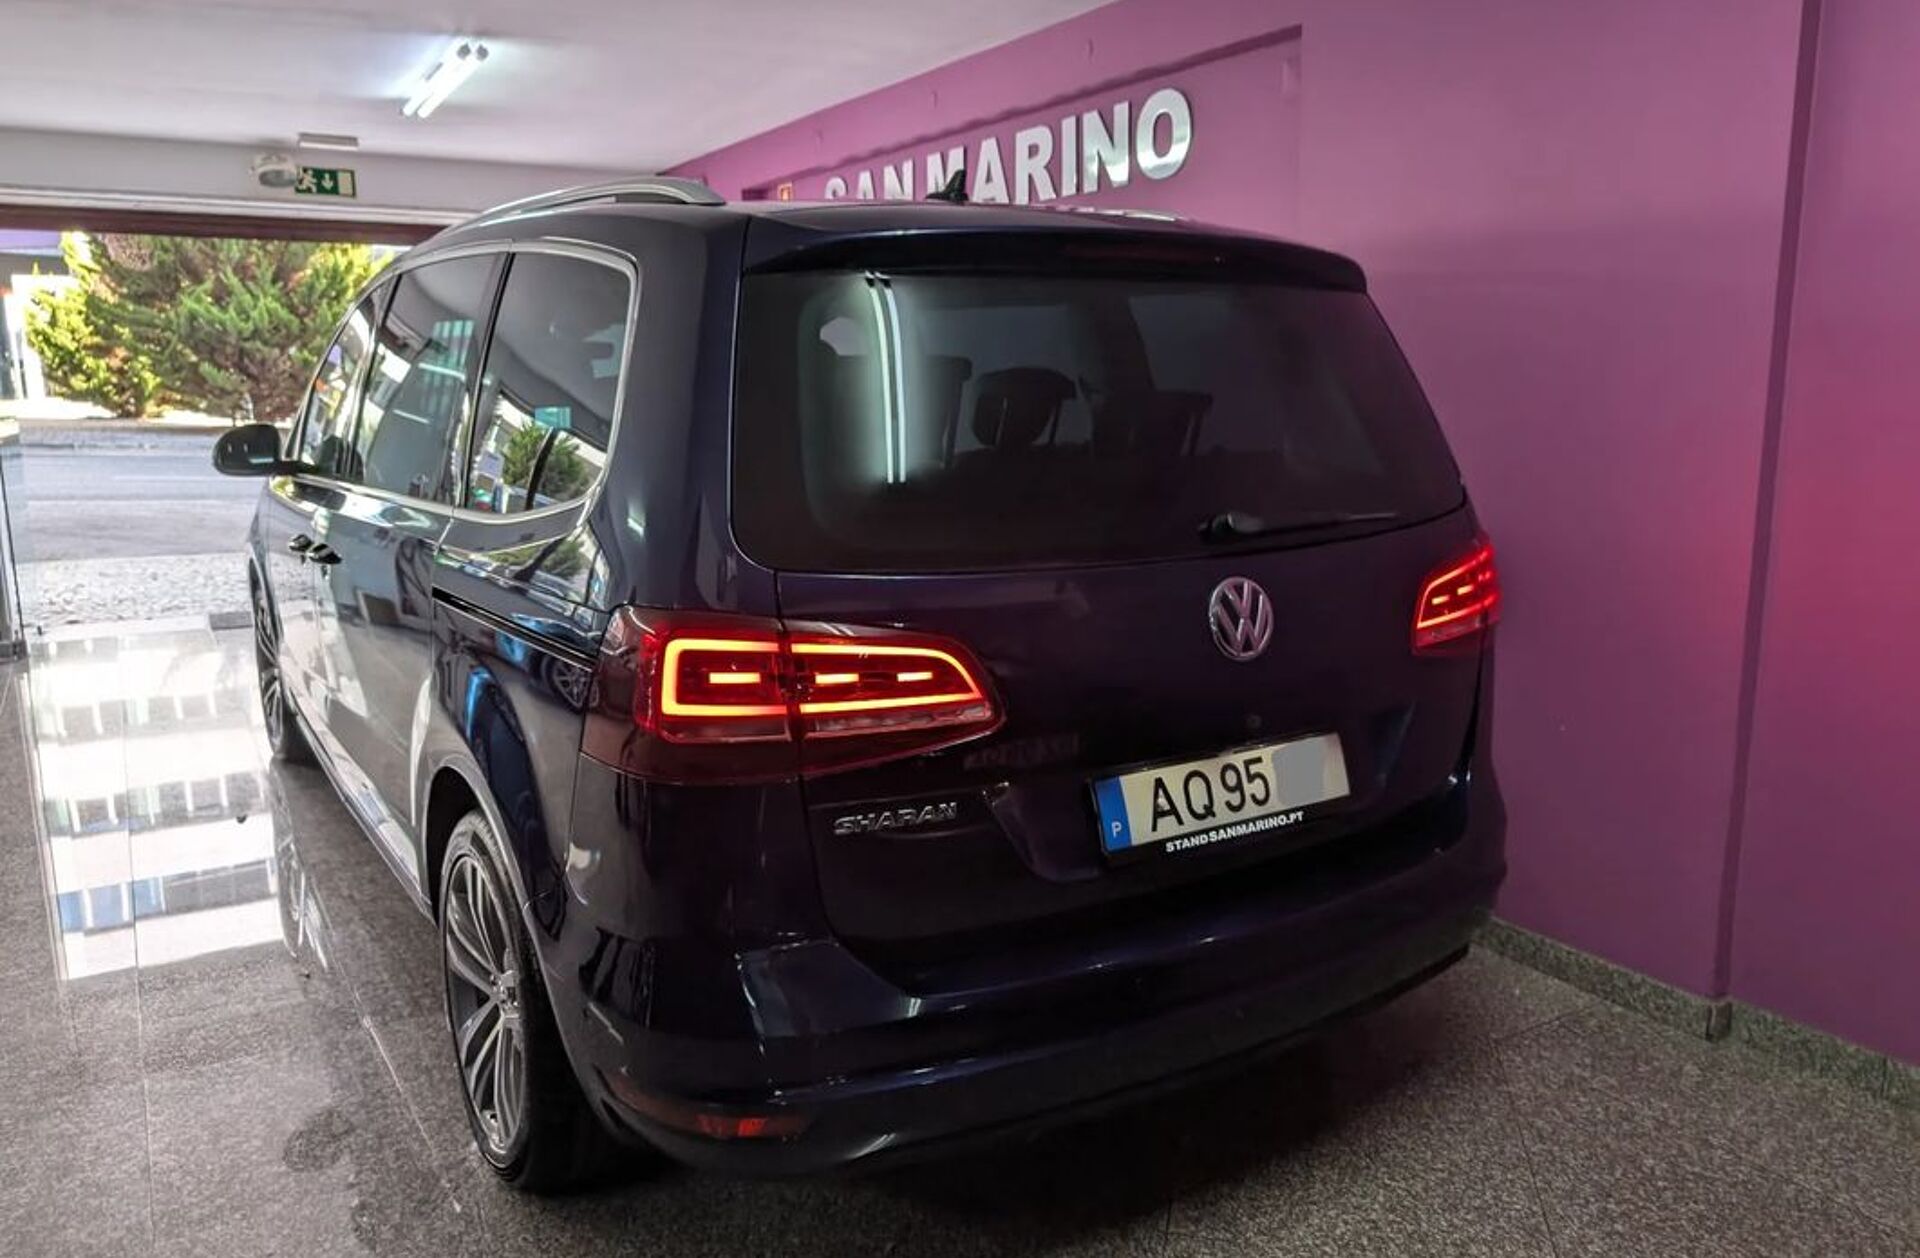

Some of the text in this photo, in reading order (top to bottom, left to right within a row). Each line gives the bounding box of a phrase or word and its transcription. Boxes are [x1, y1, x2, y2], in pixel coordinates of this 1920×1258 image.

[926, 88, 1192, 205] MARINO
[834, 802, 957, 835] SHARAN
[1111, 821, 1122, 838] P
[1166, 811, 1304, 852] STANDSANMARINO.PT
